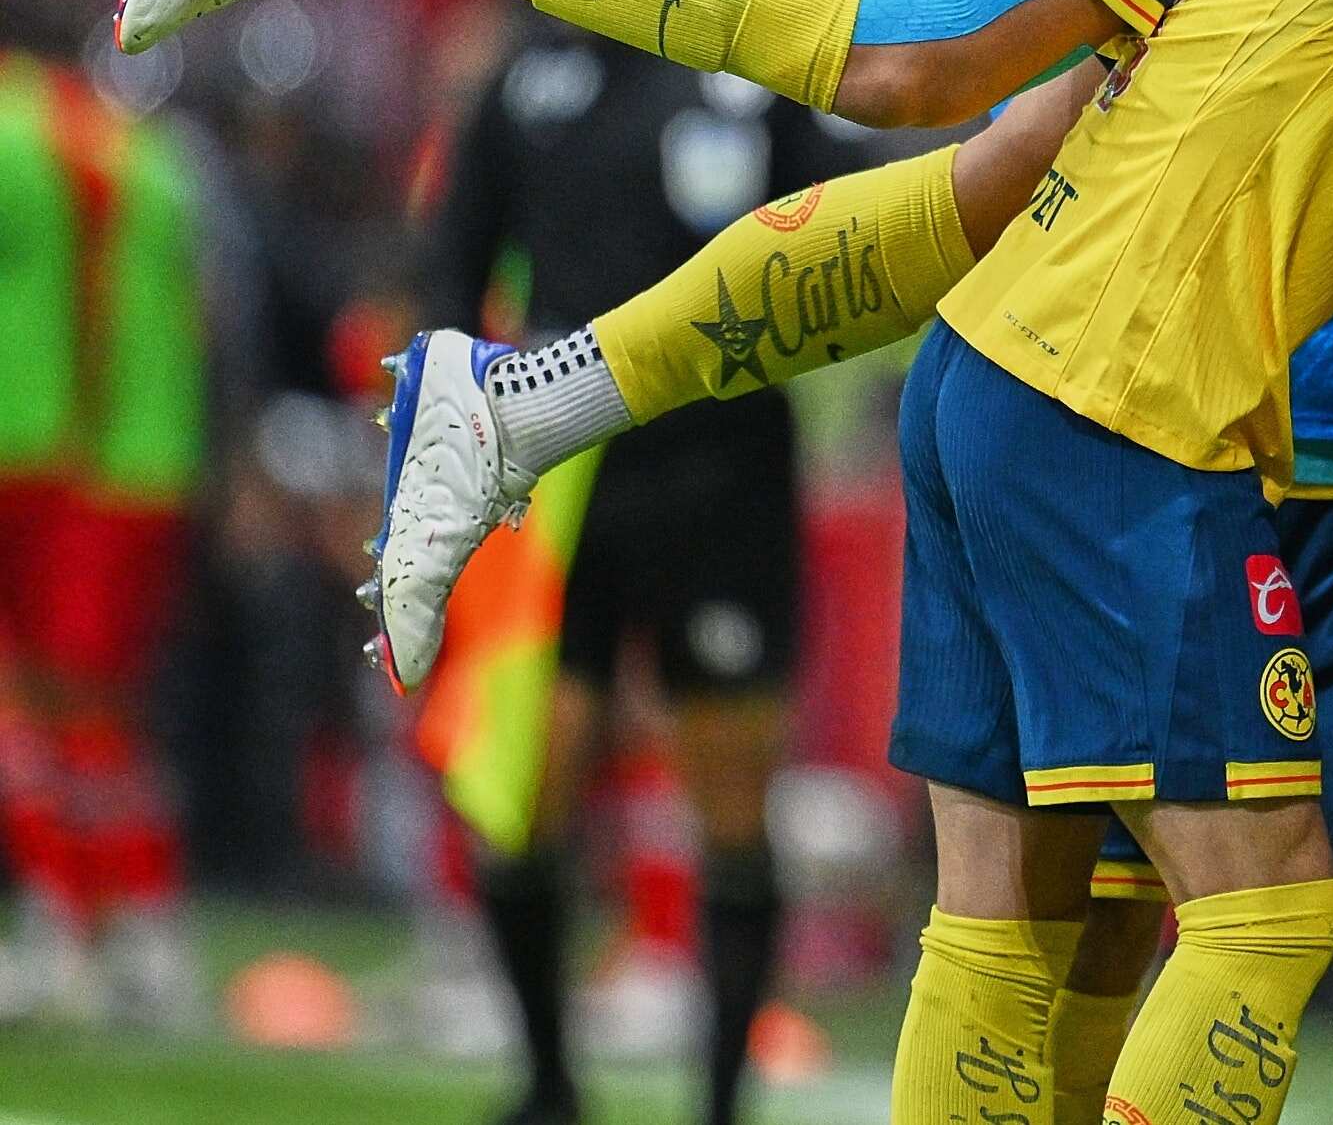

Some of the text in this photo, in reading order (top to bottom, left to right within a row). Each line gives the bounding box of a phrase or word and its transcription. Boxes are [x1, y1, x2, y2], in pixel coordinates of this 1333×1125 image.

[761, 216, 882, 358] Carl's
[470, 412, 487, 448] COPA
[956, 1035, 1041, 1104] Jr.
[1208, 1004, 1287, 1088] Jr.
